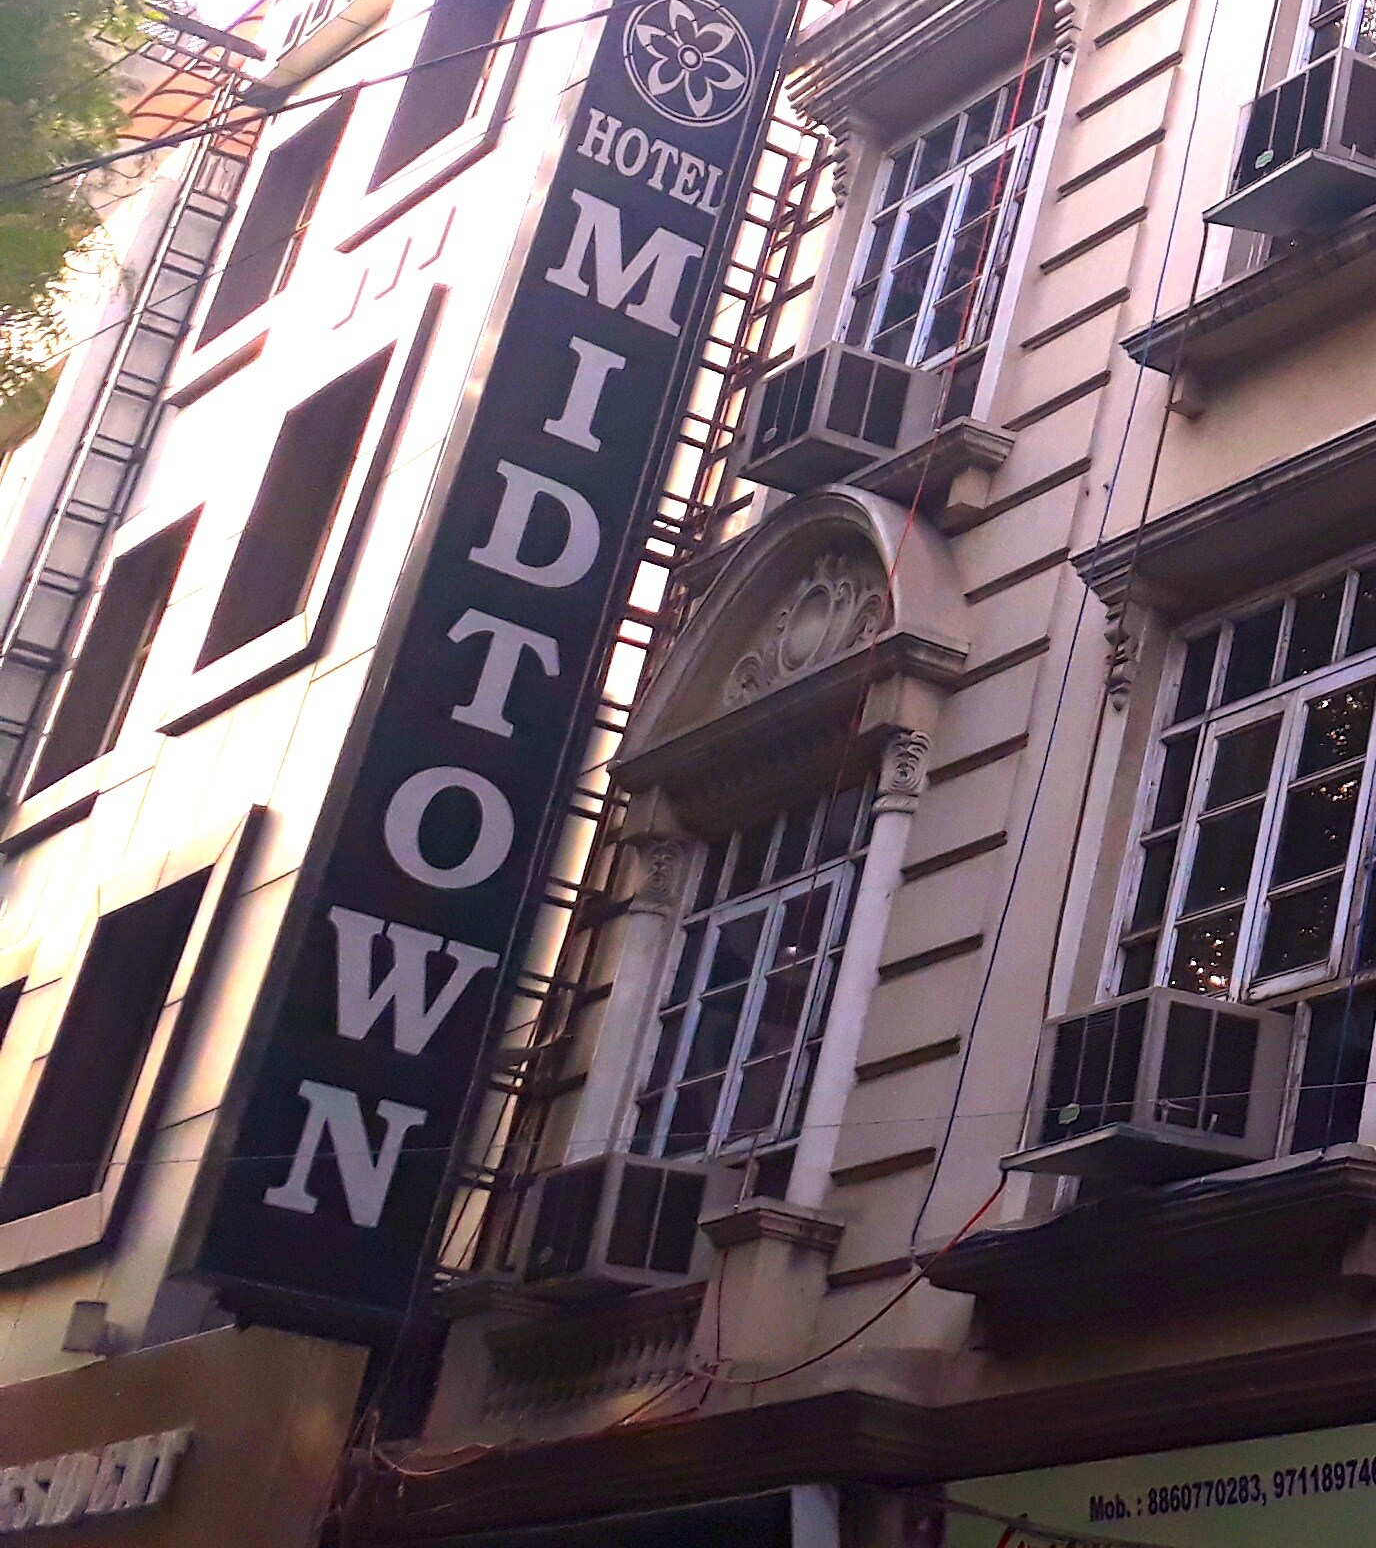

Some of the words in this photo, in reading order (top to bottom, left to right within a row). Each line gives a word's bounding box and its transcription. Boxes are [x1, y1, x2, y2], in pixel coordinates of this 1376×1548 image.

[576, 107, 725, 215] HOTEL
[263, 188, 705, 1228] MIDTOWN
[1089, 1493, 1131, 1522] Mob.
[1147, 1474, 1267, 1516] 8860770283,
